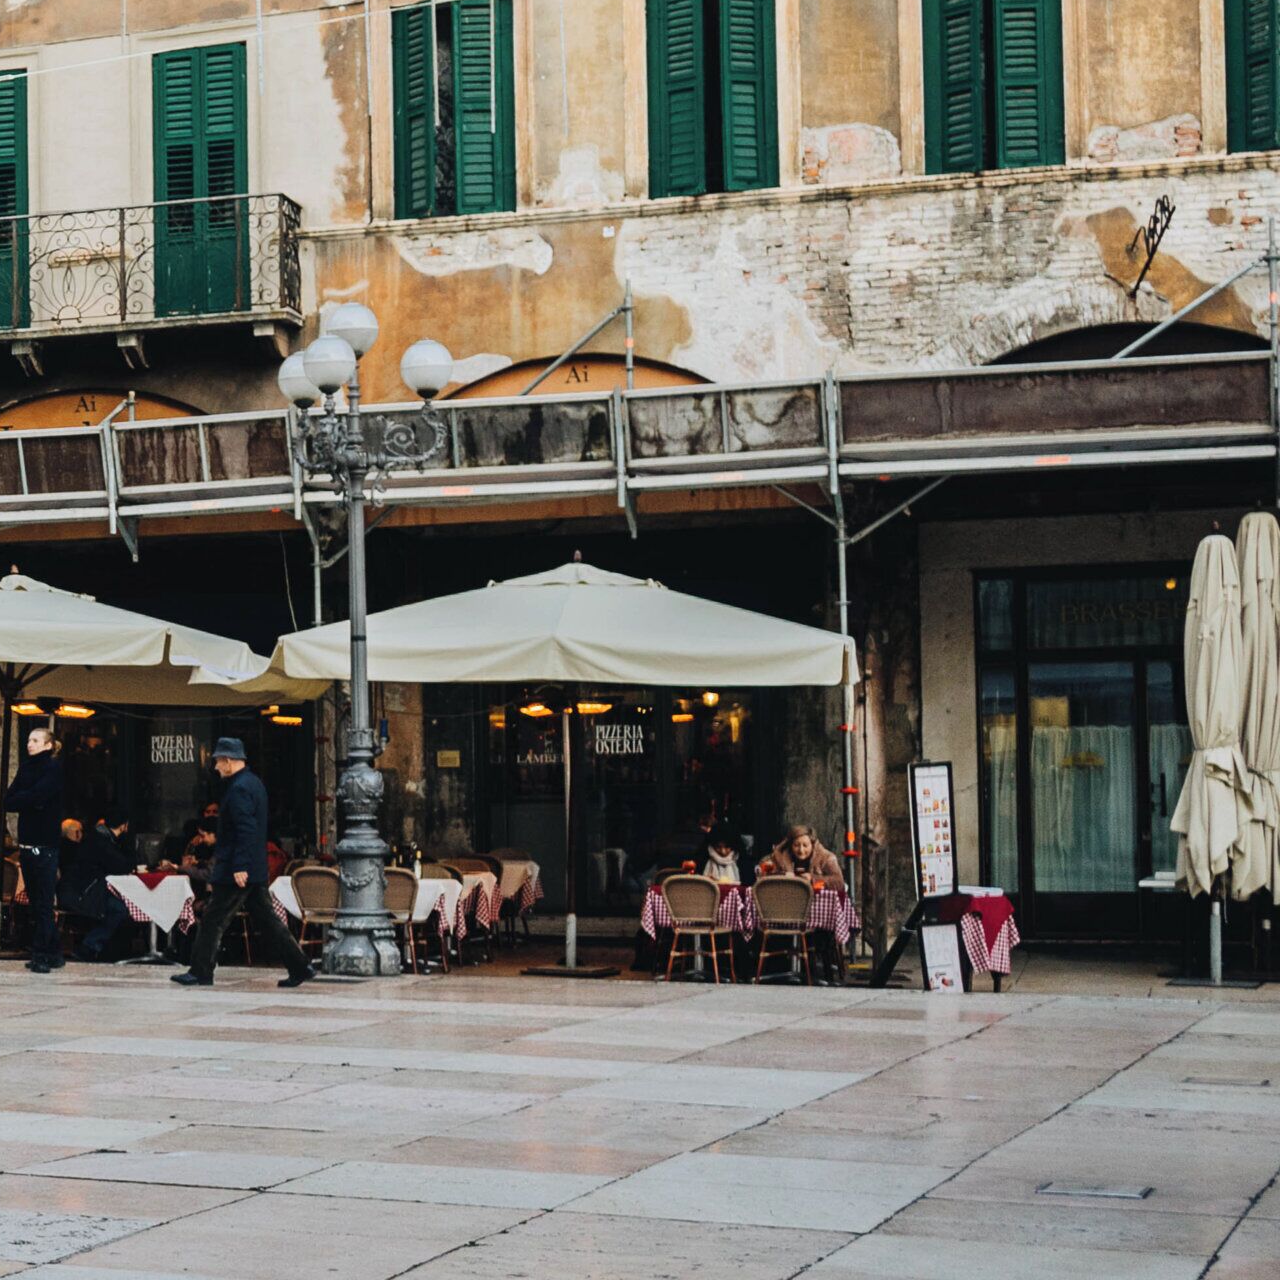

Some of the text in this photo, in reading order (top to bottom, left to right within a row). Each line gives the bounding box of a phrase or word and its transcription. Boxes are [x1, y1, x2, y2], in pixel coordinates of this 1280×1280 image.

[565, 364, 588, 384] Ai
[75, 395, 97, 413] Ai
[595, 725, 644, 739] PIZZERIA
[151, 734, 194, 749] PIZZERIA
[595, 739, 644, 754] OSTERIA
[151, 749, 195, 763] OSTERIA
